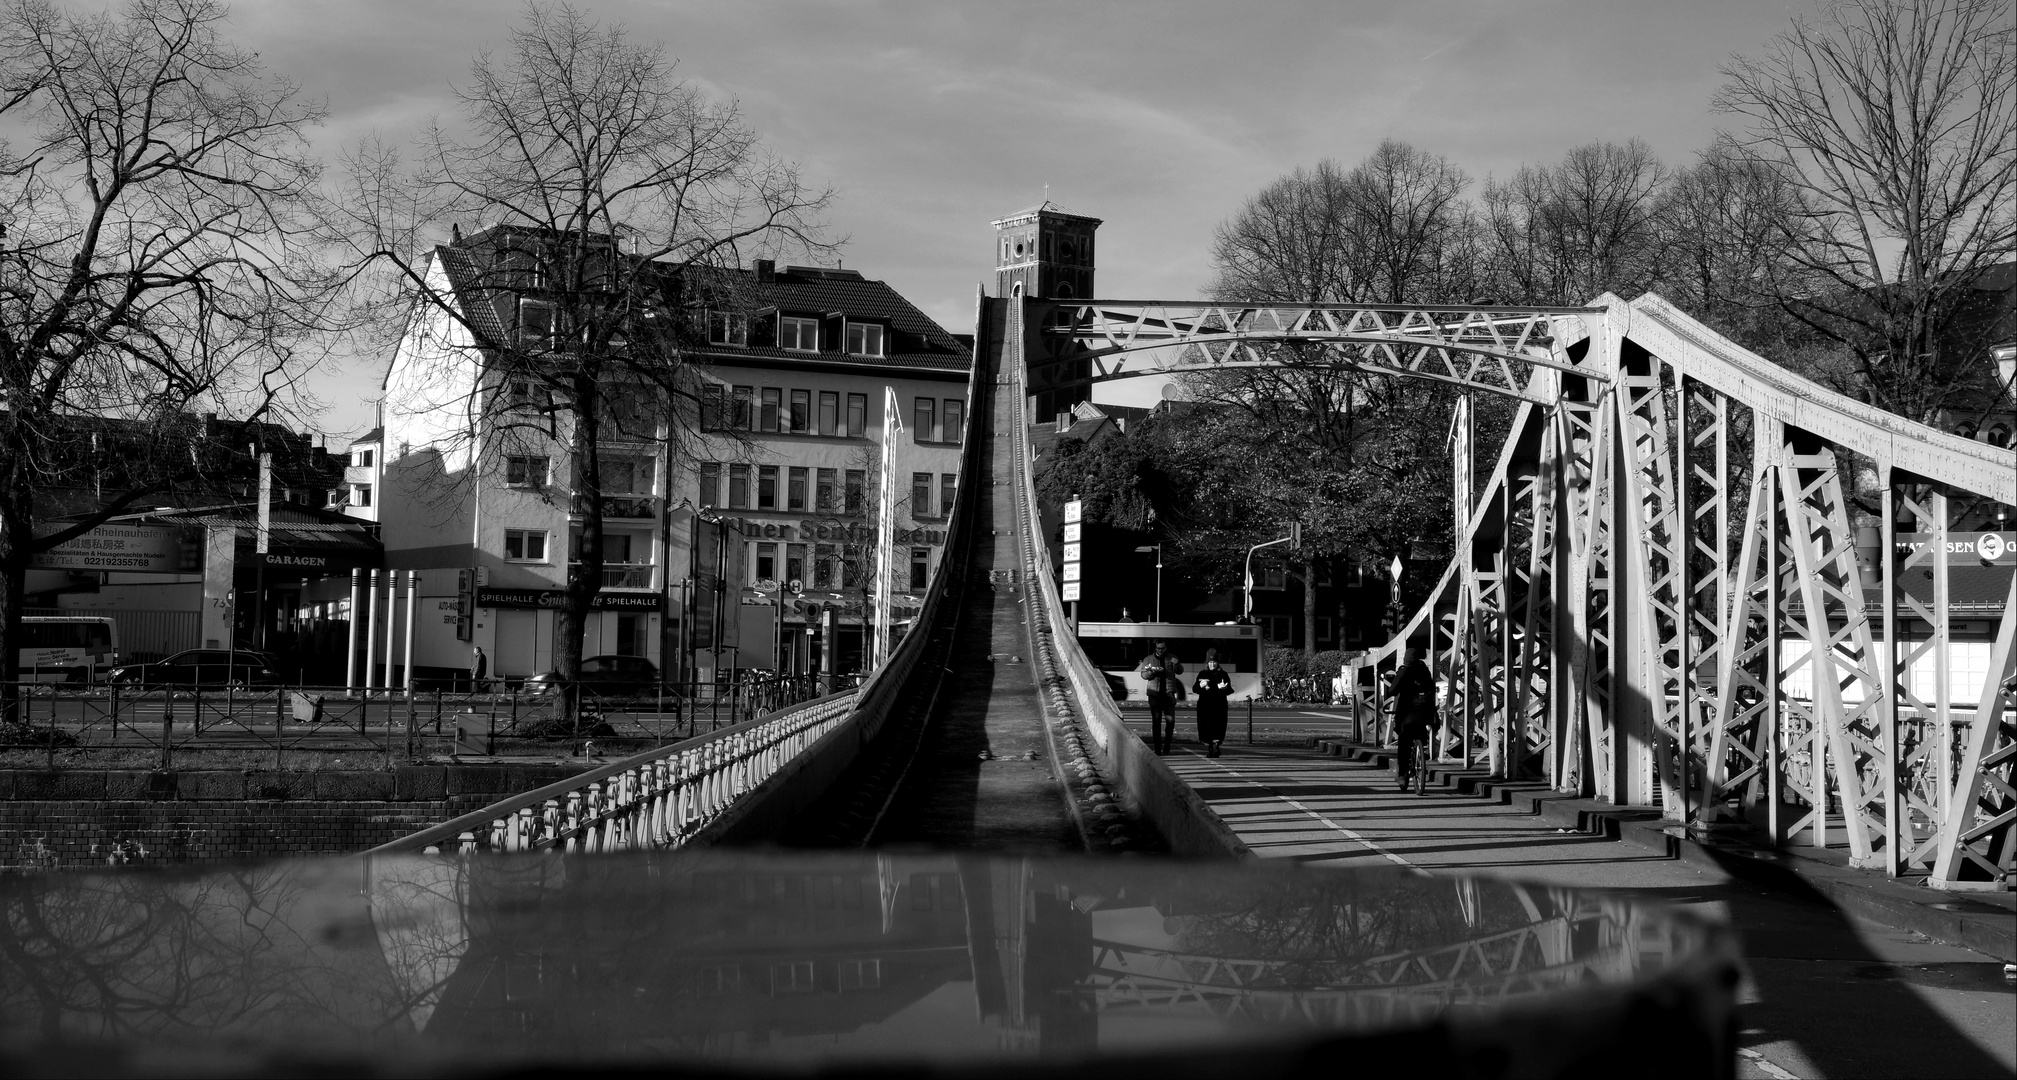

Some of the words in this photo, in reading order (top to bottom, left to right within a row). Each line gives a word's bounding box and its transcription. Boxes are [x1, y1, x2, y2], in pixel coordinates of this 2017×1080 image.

[97, 551, 142, 559] Hausgemachte
[265, 554, 326, 566] GARAGEN
[84, 557, 149, 567] 022192355768
[213, 598, 226, 608] 73
[481, 594, 534, 603] SPIELHALLE
[606, 597, 657, 606] SPIELHALLE
